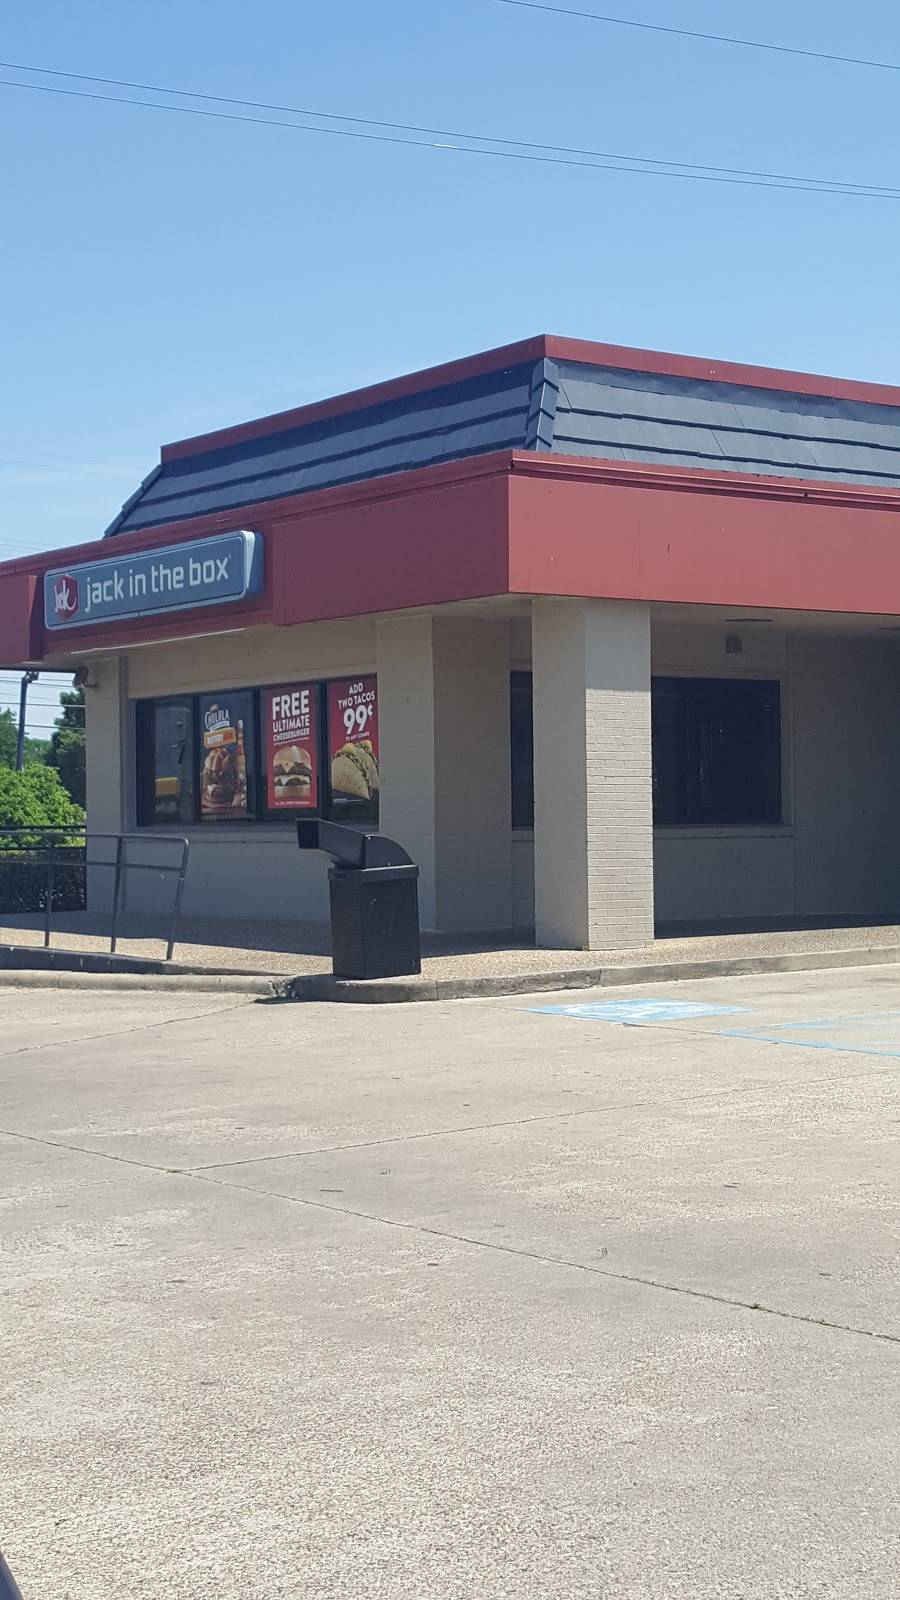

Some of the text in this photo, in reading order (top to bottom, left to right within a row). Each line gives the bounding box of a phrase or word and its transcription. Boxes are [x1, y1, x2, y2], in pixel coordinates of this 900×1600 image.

[85, 556, 229, 612] jack in the box
[349, 682, 364, 695] ADD
[272, 690, 310, 721] FREE
[338, 690, 376, 709] TWO TACOS
[272, 714, 310, 732] ULTIMATE
[273, 727, 310, 742] CHEESEBURGER
